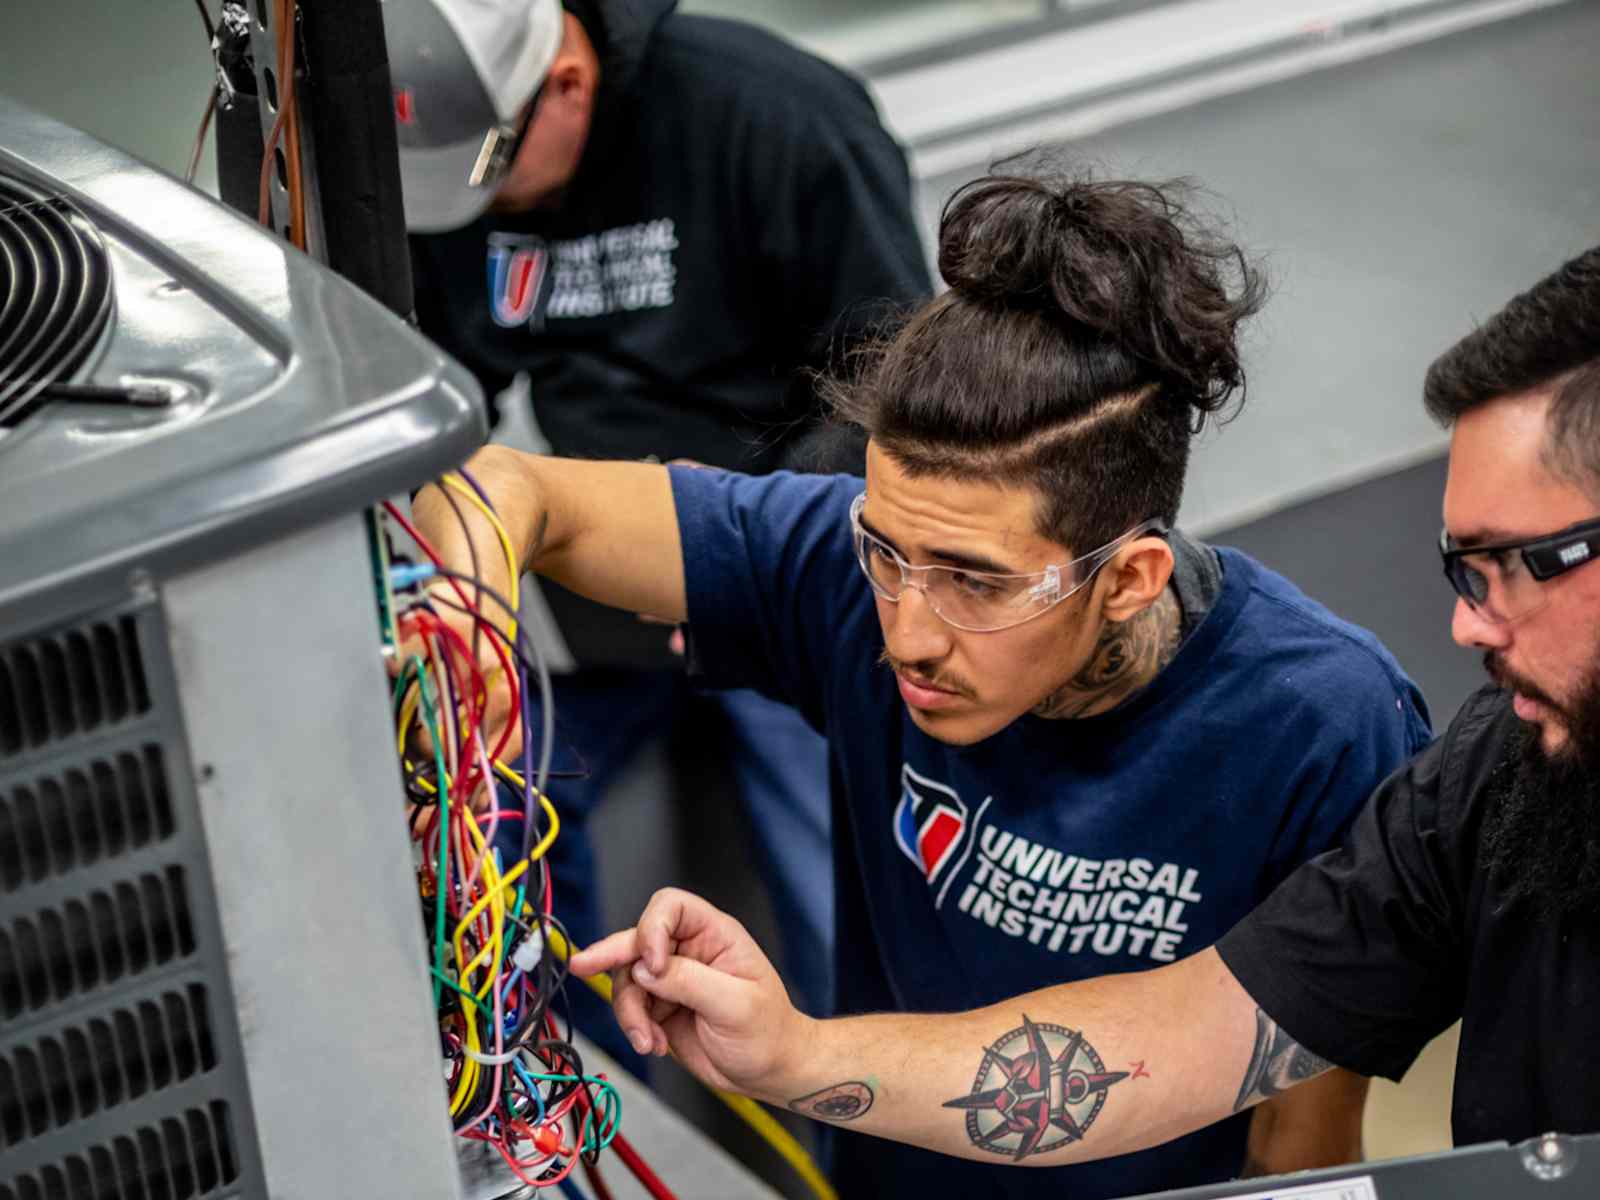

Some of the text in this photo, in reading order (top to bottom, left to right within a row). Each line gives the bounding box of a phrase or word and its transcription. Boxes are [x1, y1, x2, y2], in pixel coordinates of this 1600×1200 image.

[972, 853, 1189, 933] TECHNICAL
[979, 824, 1202, 903] UNIVERSAL
[958, 883, 1184, 962] INSTITUTE
